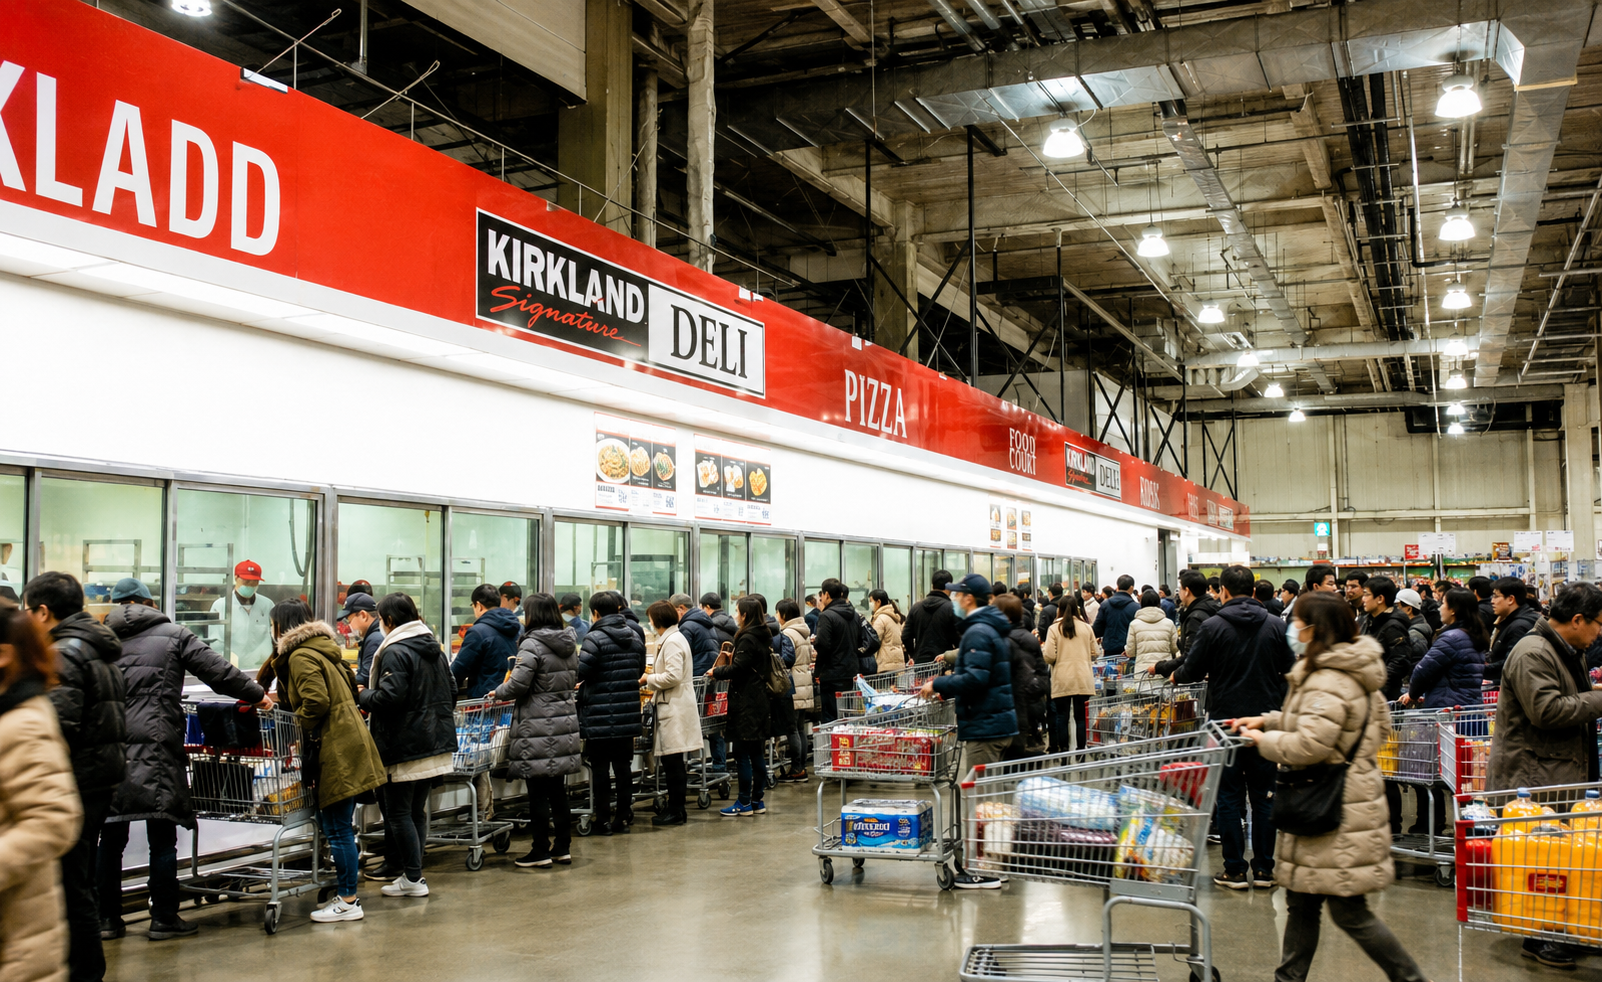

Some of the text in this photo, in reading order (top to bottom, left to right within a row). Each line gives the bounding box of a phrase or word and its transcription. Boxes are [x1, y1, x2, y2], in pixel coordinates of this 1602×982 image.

[487, 229, 748, 379] KIRKLAND DELI
[490, 285, 642, 347] Signature
[844, 369, 908, 438] PIZZA
[1009, 427, 1036, 455] FOOD
[1009, 447, 1037, 476] COURT
